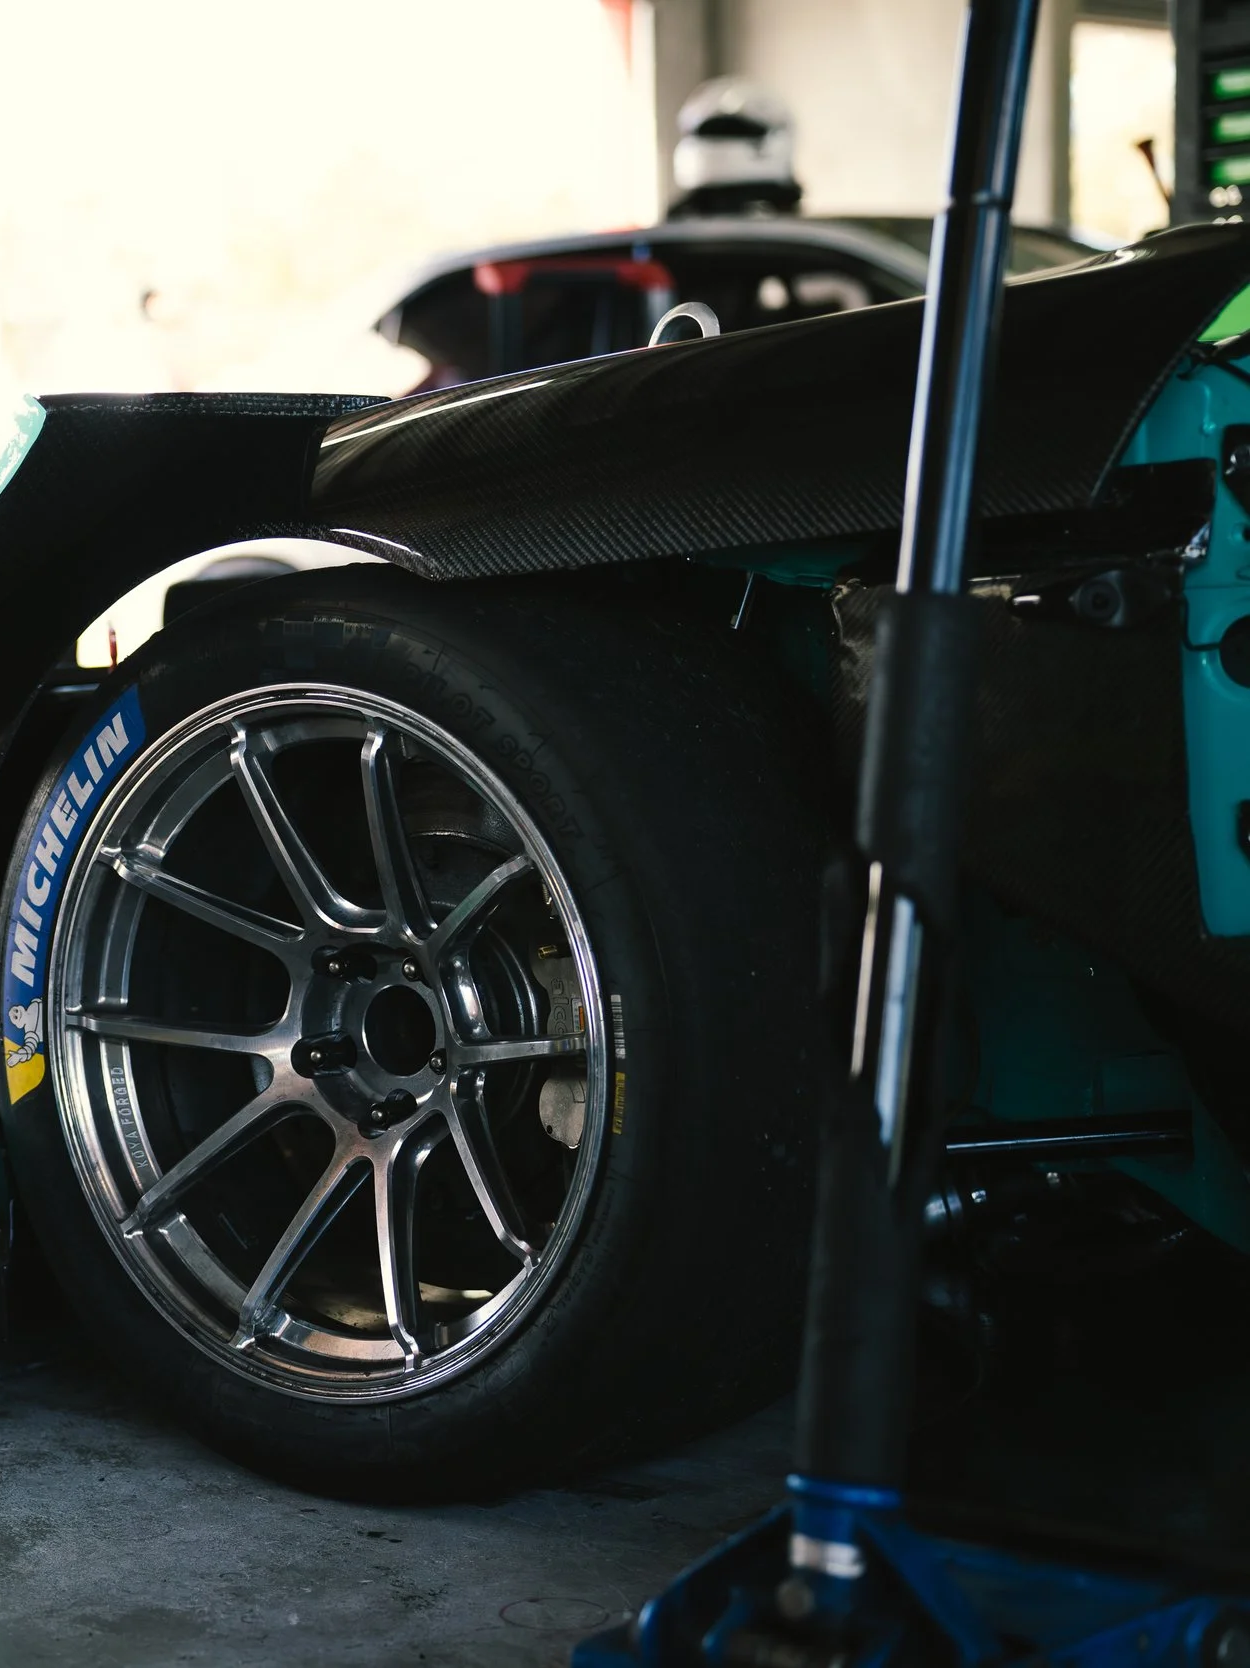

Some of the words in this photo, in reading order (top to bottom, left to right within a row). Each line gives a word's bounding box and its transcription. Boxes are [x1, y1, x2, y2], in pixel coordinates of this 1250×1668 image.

[499, 733, 585, 838] SPORT
[10, 711, 130, 988] MICHELIN
[110, 1066, 135, 1126] FORGED
[125, 1130, 149, 1169] KOYA
